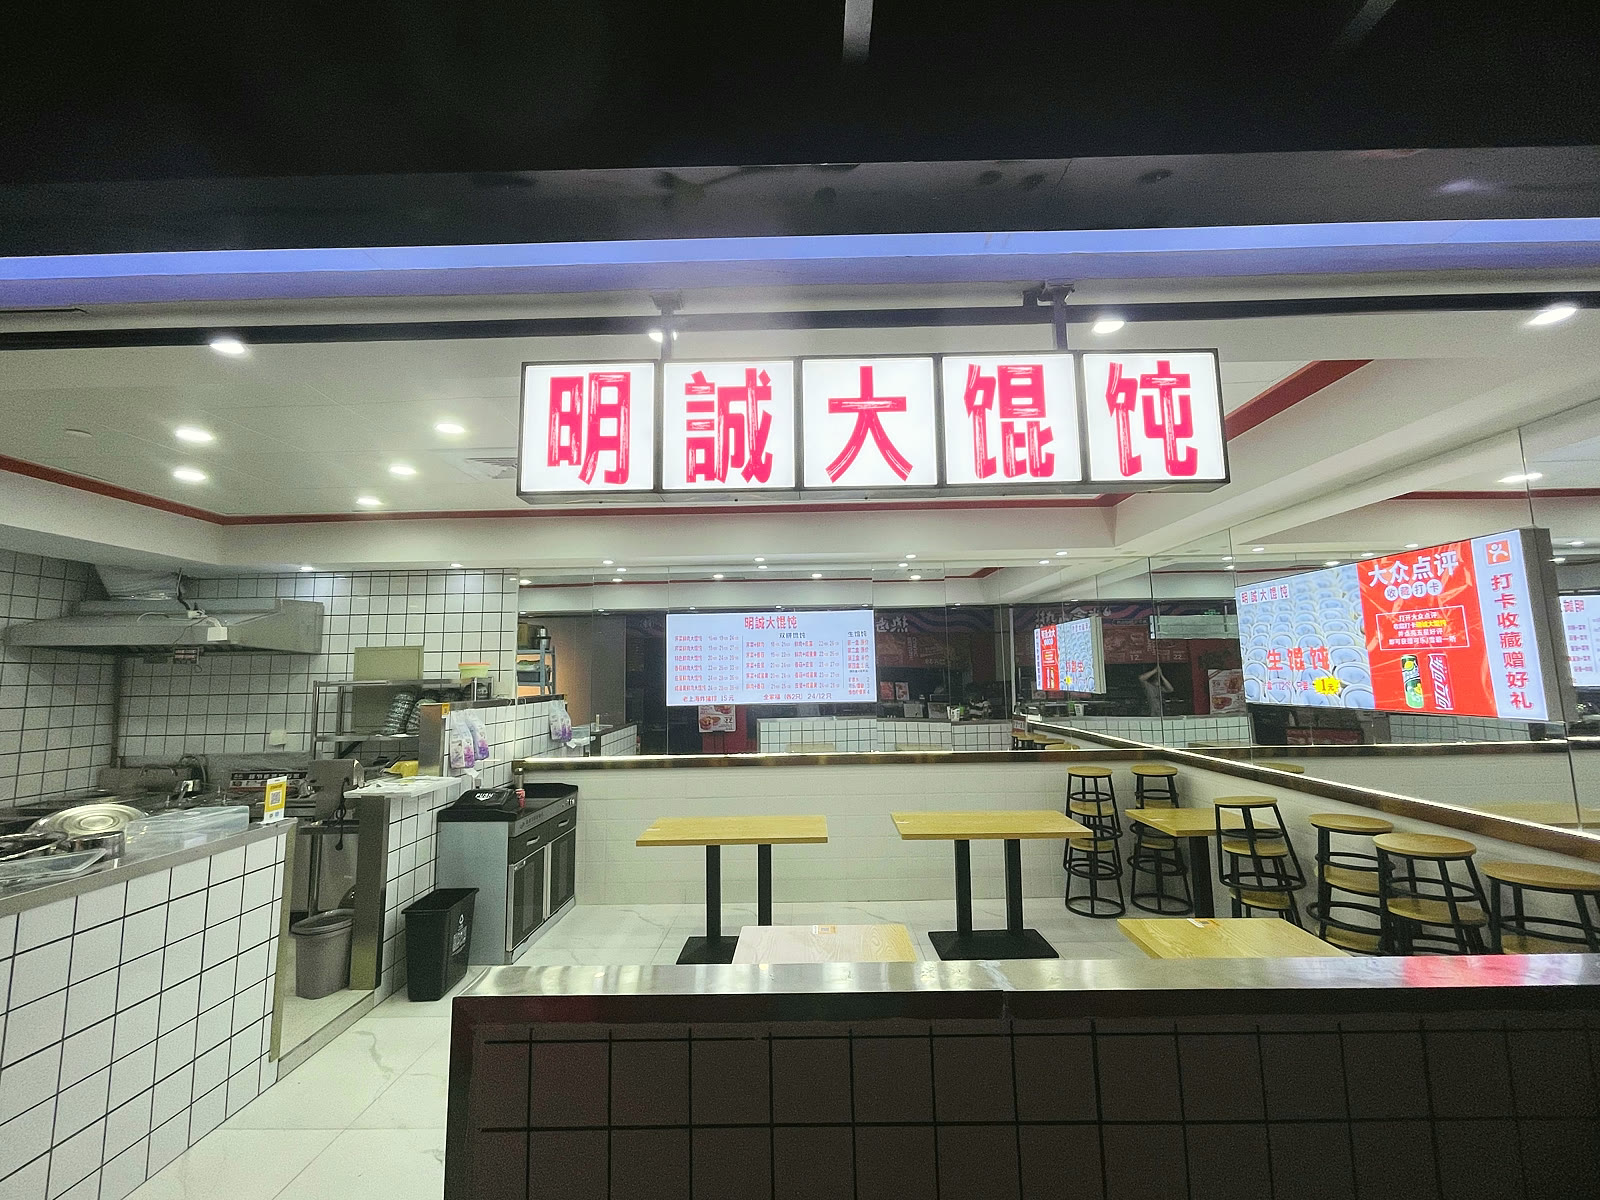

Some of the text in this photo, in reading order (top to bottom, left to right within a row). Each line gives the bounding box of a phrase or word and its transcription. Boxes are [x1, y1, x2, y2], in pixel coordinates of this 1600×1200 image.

[547, 360, 1198, 484] 明誠大馄饨
[1368, 551, 1458, 587] 大众点评
[1386, 581, 1440, 599] 收藏打卡
[744, 616, 797, 629] 明誠大馄饨
[1491, 573, 1533, 710] 打卡收藏赠好礼
[1267, 646, 1329, 670] 生馄饨
